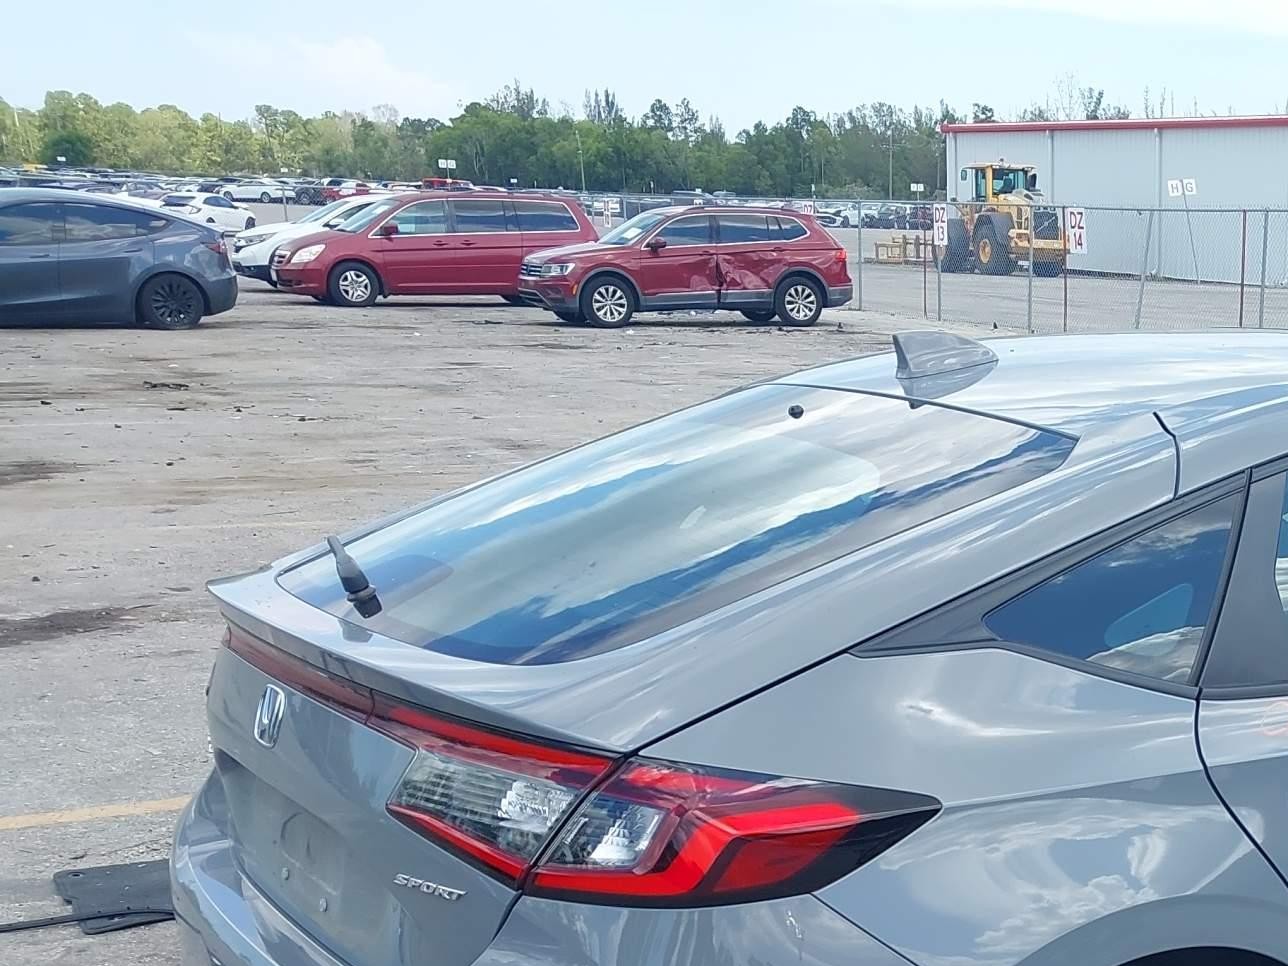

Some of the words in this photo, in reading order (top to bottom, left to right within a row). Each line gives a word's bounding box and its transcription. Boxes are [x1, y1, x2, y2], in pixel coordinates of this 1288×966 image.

[1170, 183, 1179, 193] H
[1185, 182, 1194, 193] G
[934, 207, 946, 224] DZ
[1069, 211, 1085, 230] DZ
[936, 225, 945, 242] 13
[1073, 233, 1084, 250] 14
[392, 873, 468, 901] SPORT
